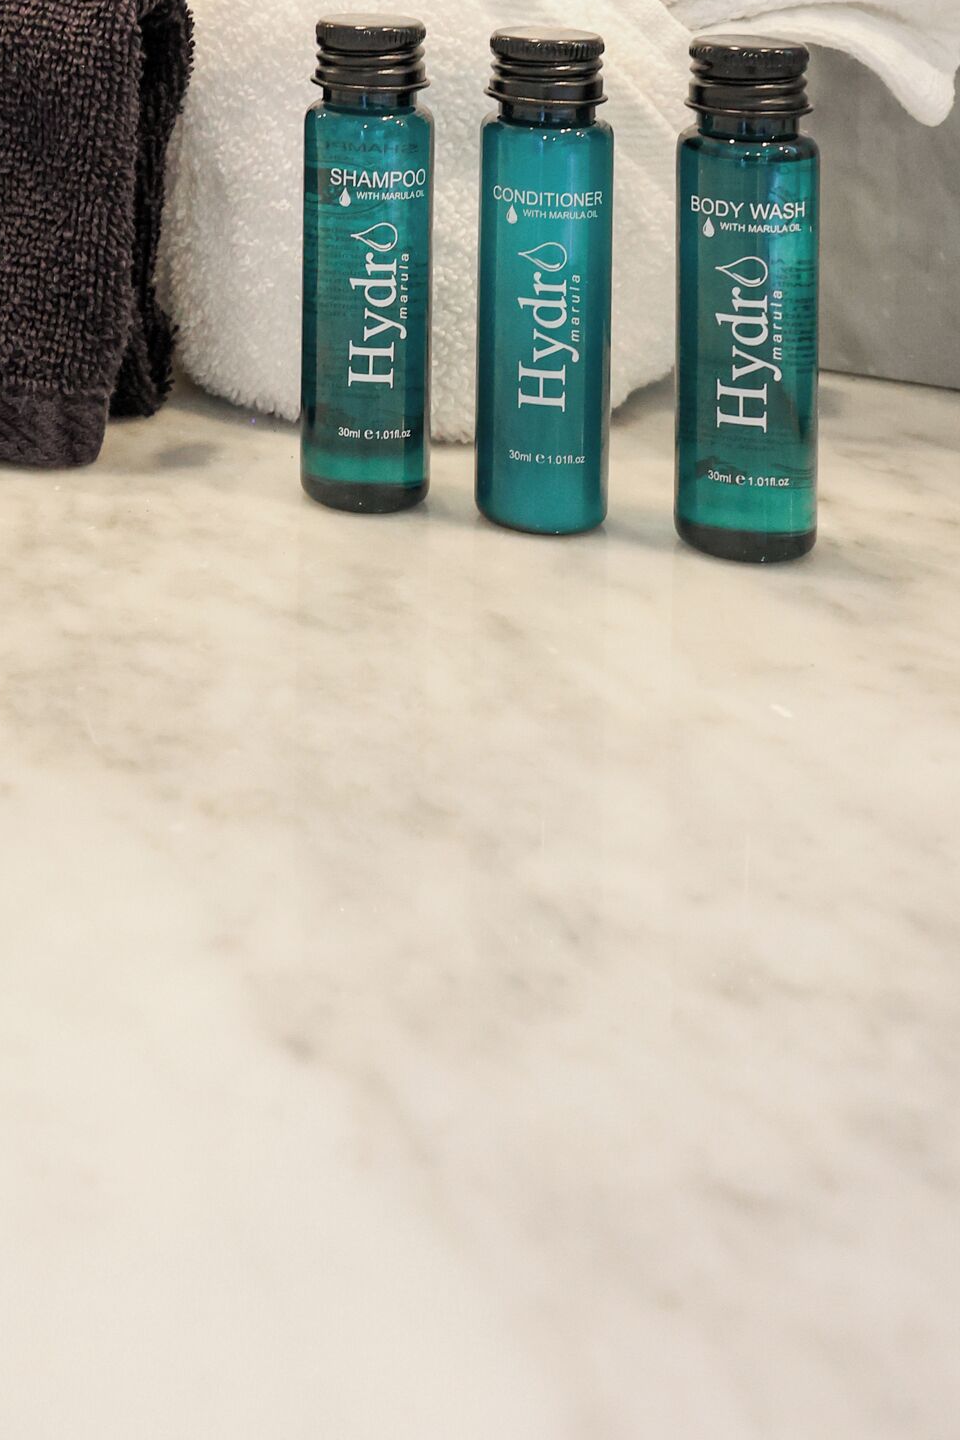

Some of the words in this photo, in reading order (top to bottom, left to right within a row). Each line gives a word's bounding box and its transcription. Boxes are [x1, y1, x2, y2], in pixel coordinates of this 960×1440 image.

[329, 167, 426, 189] SHAMPOO
[356, 190, 380, 201] WITH
[381, 191, 415, 201] MARULA
[415, 189, 425, 198] OIL
[493, 185, 603, 208] CONDITIONER
[523, 209, 546, 219] WITH
[549, 210, 586, 220] MARULA
[586, 210, 598, 219] OIL
[690, 195, 745, 219] BODY
[750, 201, 805, 220] WASH
[720, 221, 746, 232] WITH
[748, 224, 788, 233] MARULA
[789, 223, 801, 232] OIL
[399, 253, 410, 320] marula
[569, 274, 581, 343] marula
[771, 289, 784, 361] marula
[338, 426, 361, 440] 30ml
[509, 449, 532, 463] 30ml
[707, 469, 732, 484] 30ml
